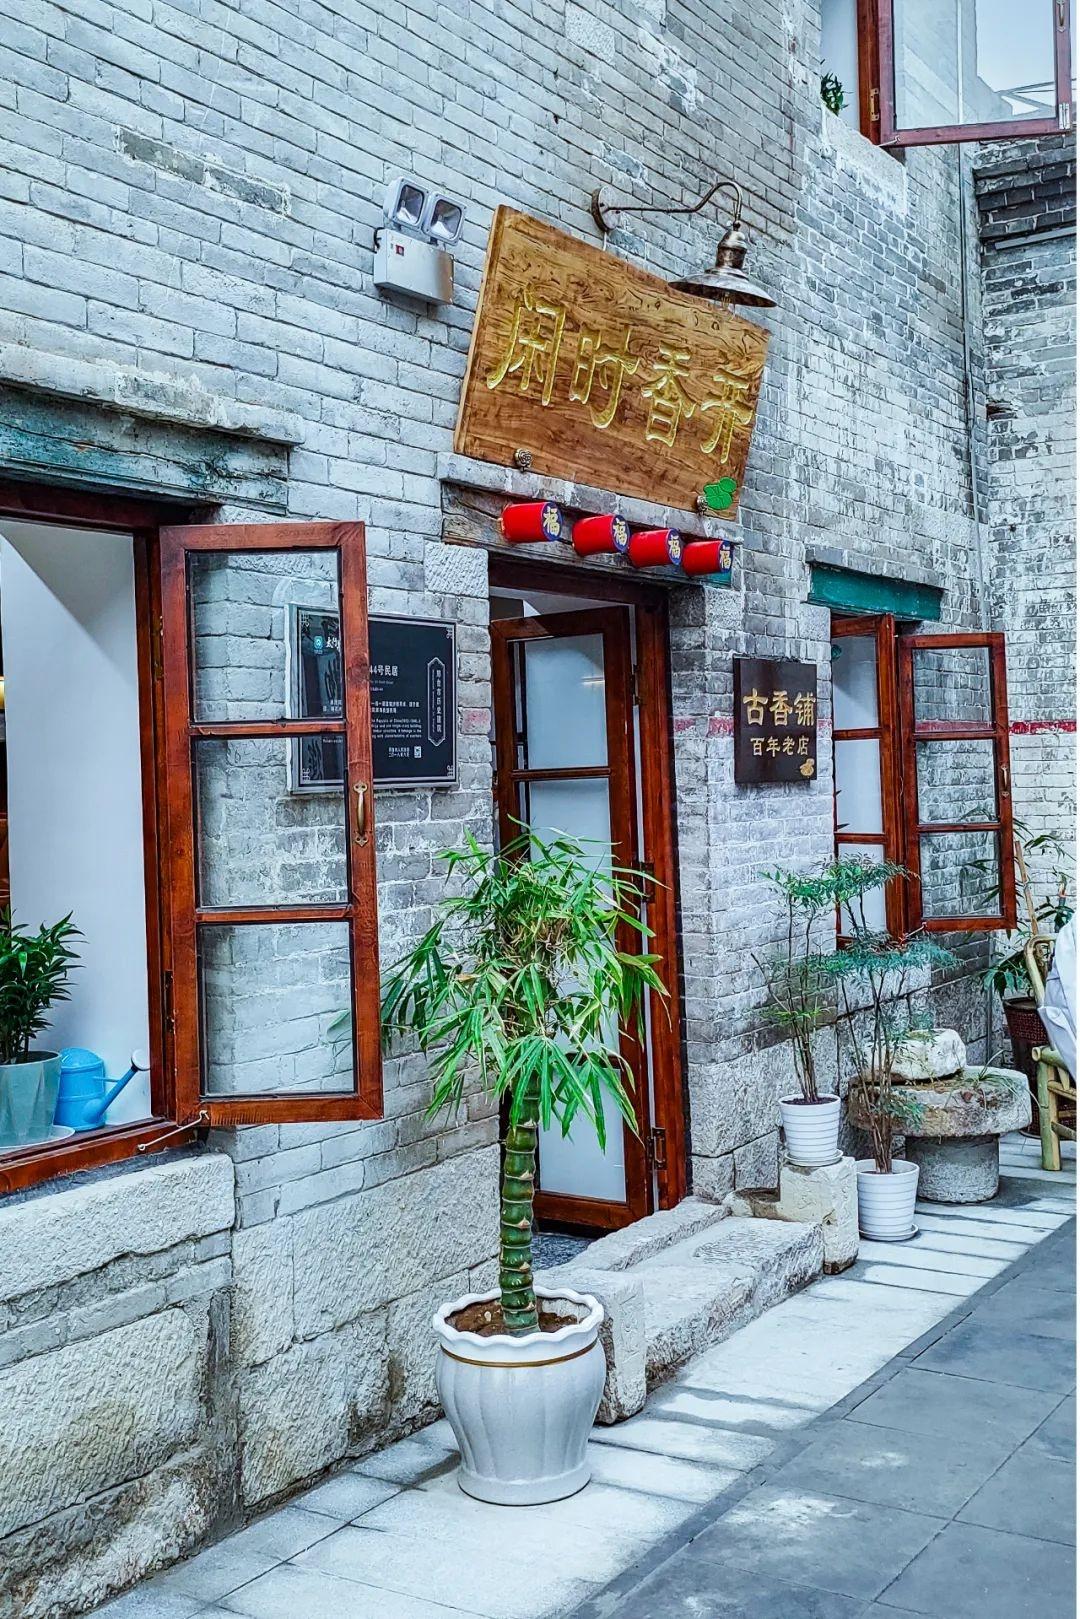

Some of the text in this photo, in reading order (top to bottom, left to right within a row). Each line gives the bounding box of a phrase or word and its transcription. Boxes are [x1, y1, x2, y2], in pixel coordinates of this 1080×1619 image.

[543, 506, 560, 535] 福
[613, 517, 628, 546] 福
[668, 535, 682, 558] 福
[743, 688, 816, 726] 古香铺
[750, 735, 810, 757] 百年老店
